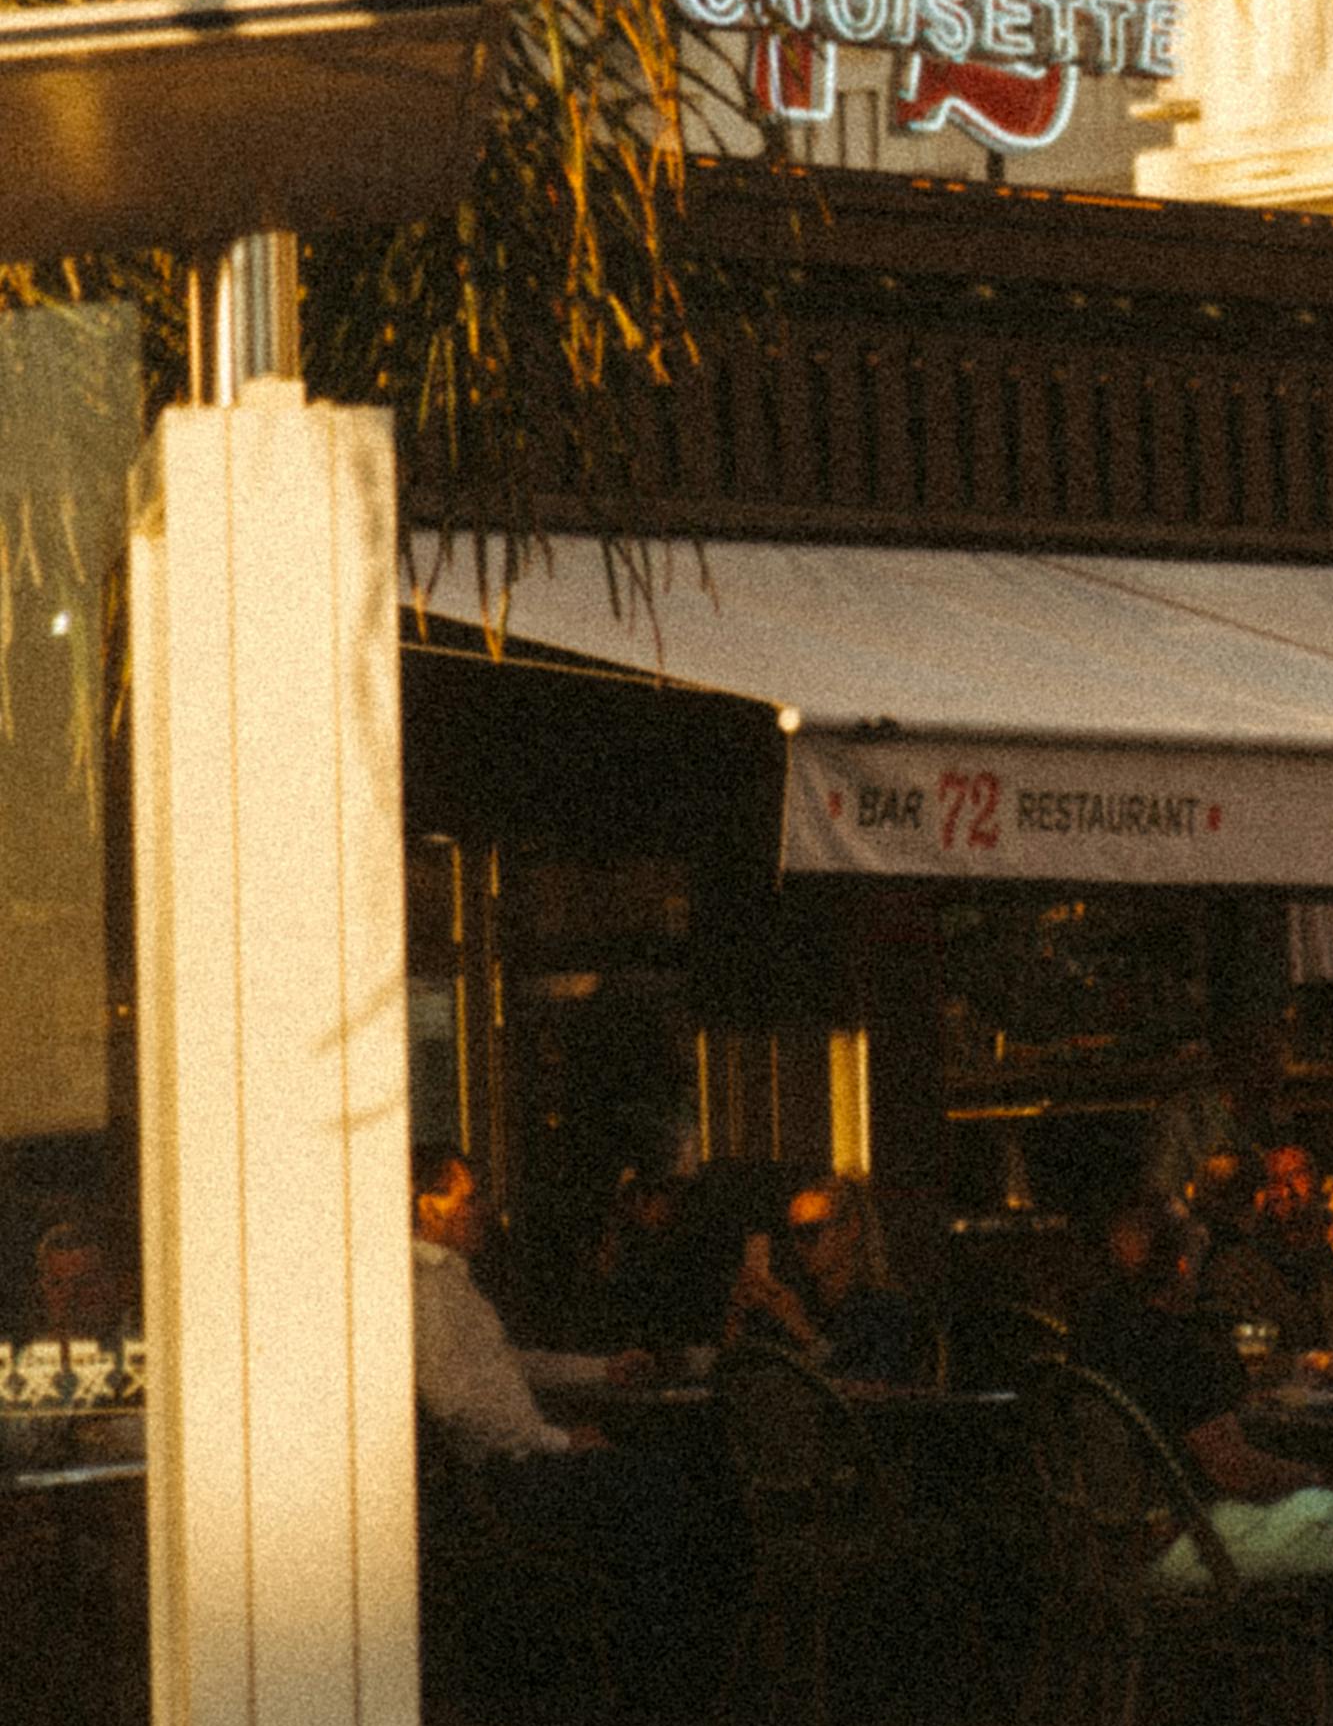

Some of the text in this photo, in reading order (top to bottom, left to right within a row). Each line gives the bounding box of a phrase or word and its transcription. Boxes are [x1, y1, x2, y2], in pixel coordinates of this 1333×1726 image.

[857, 771, 1200, 851] BAR 72 RESTAURANT
